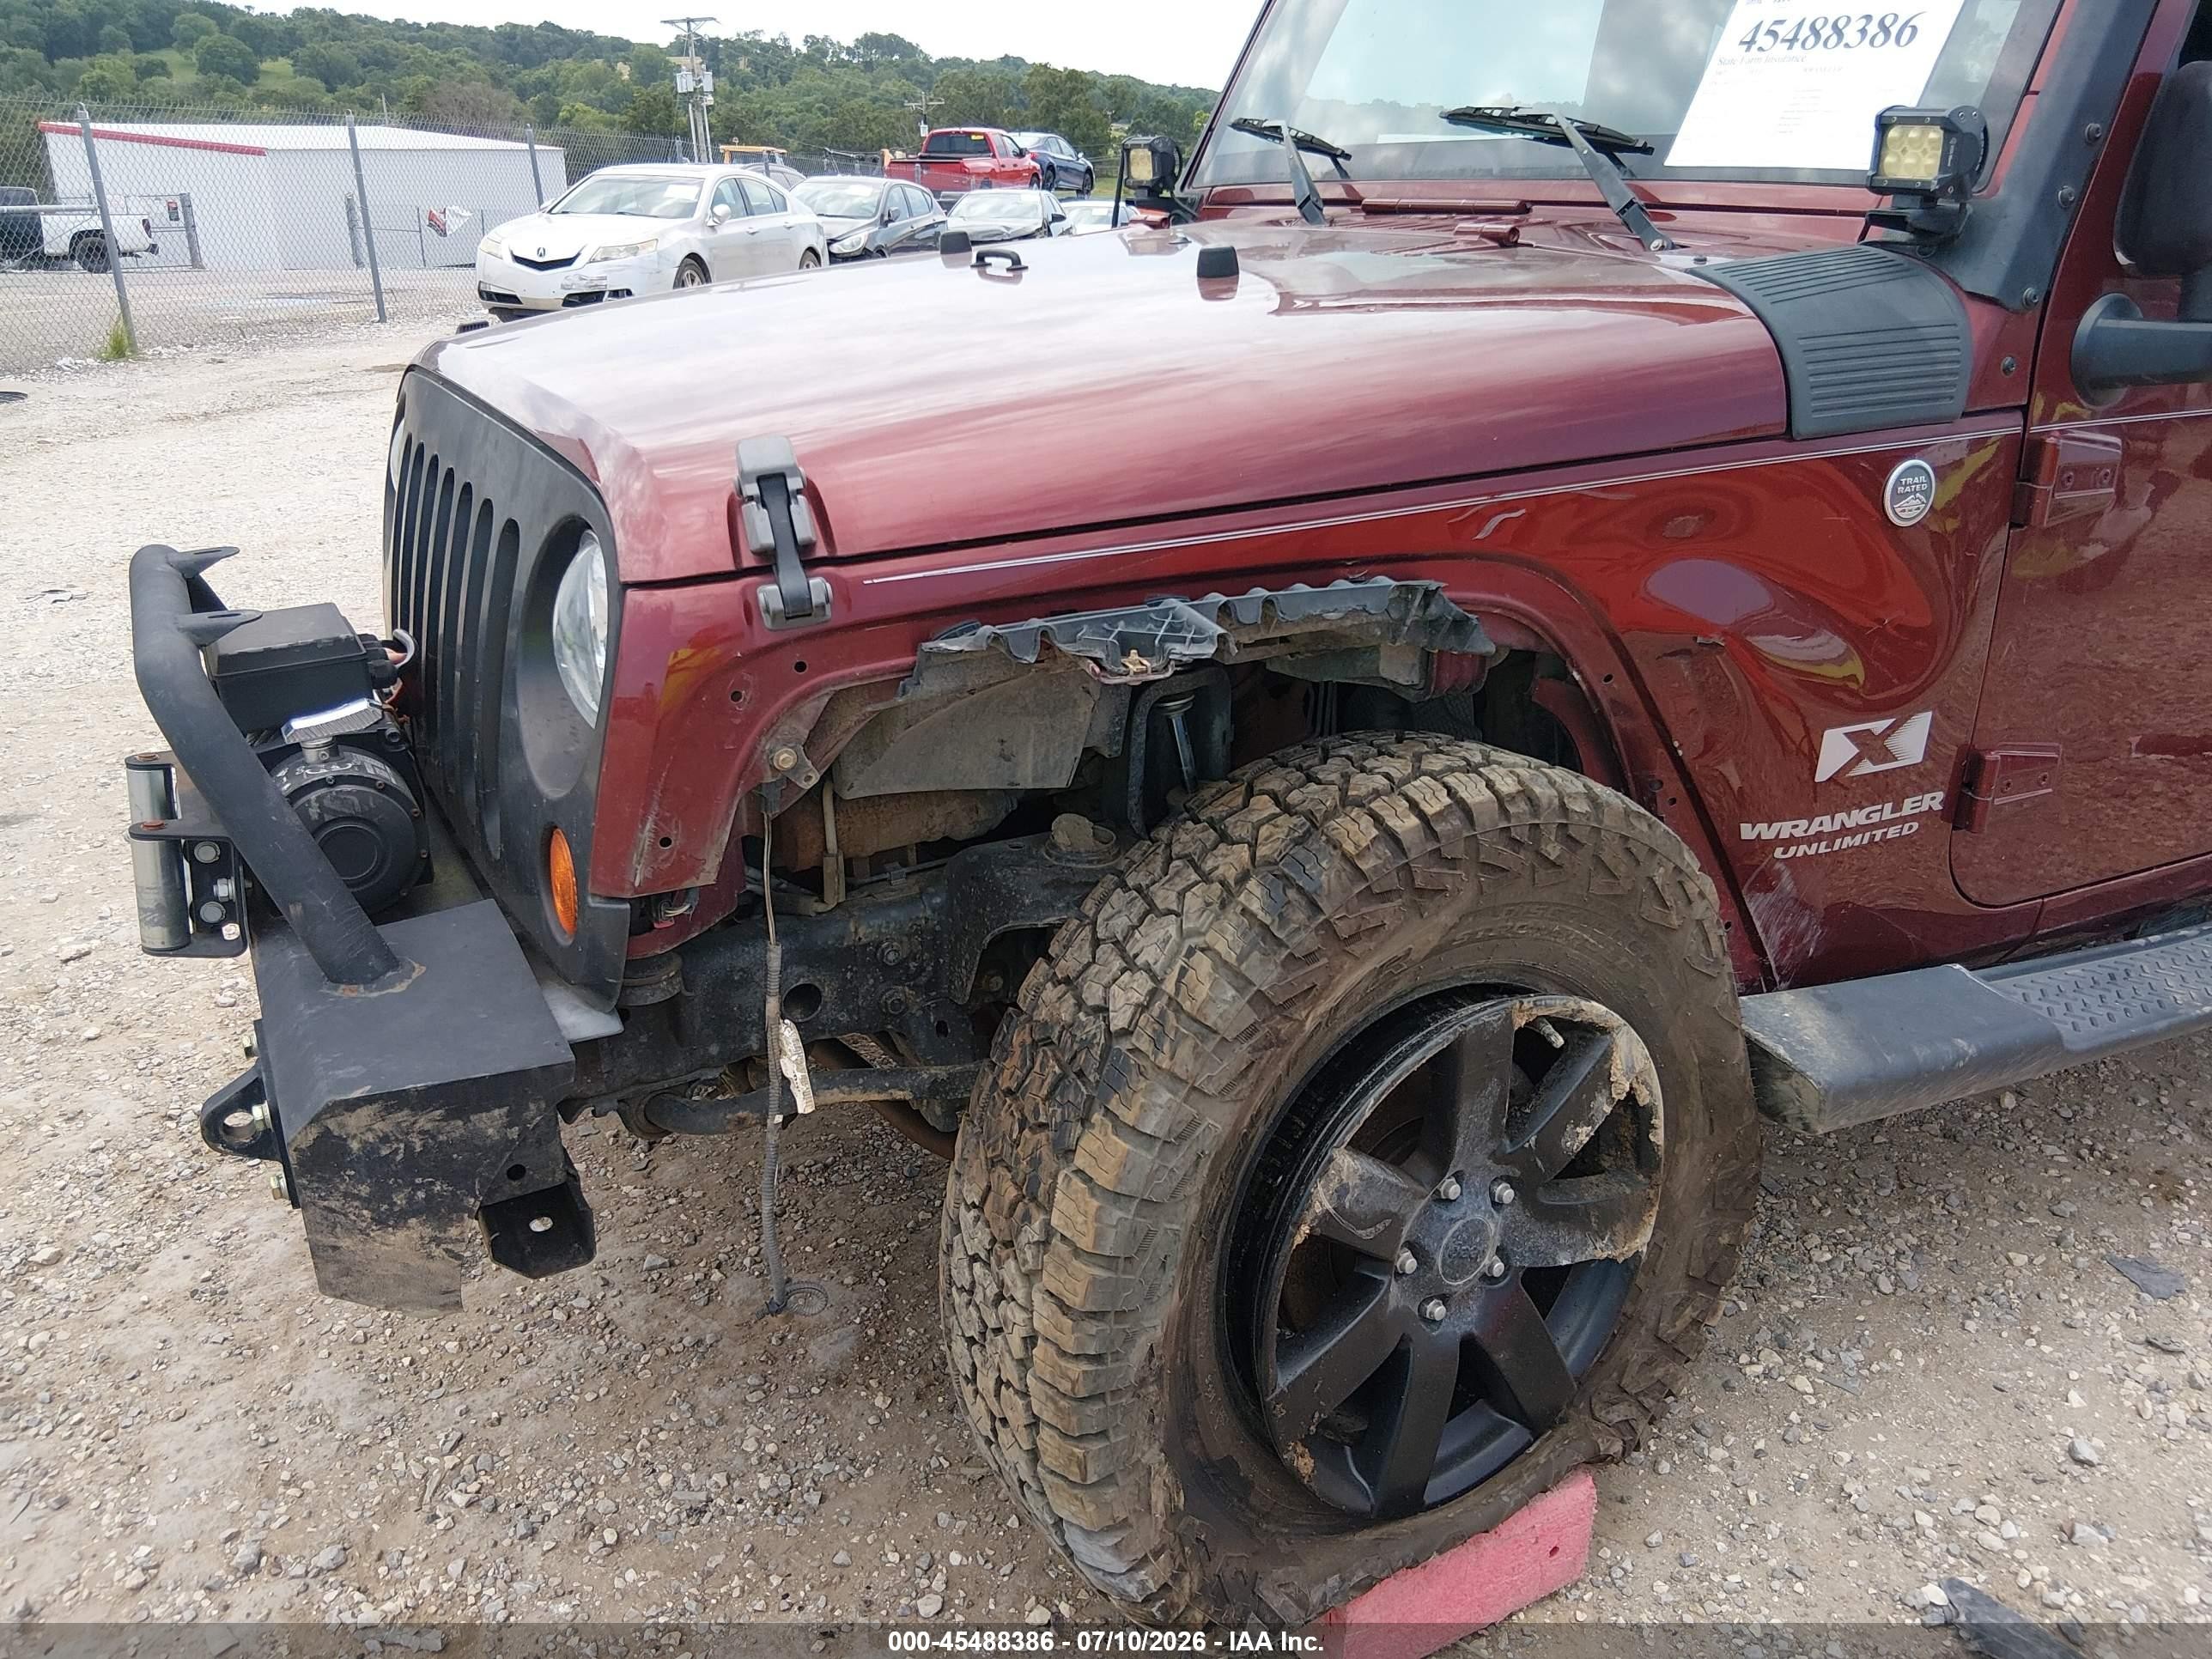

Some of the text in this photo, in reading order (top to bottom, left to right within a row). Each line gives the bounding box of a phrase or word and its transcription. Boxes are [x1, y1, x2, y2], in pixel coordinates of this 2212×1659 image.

[1738, 11, 1928, 52] 45488386
[1897, 483, 1928, 495] RATED
[1899, 476, 1927, 486] TRAIL
[1740, 791, 1944, 841] WRANGLER
[1773, 822, 1919, 859] UNLIMITED
